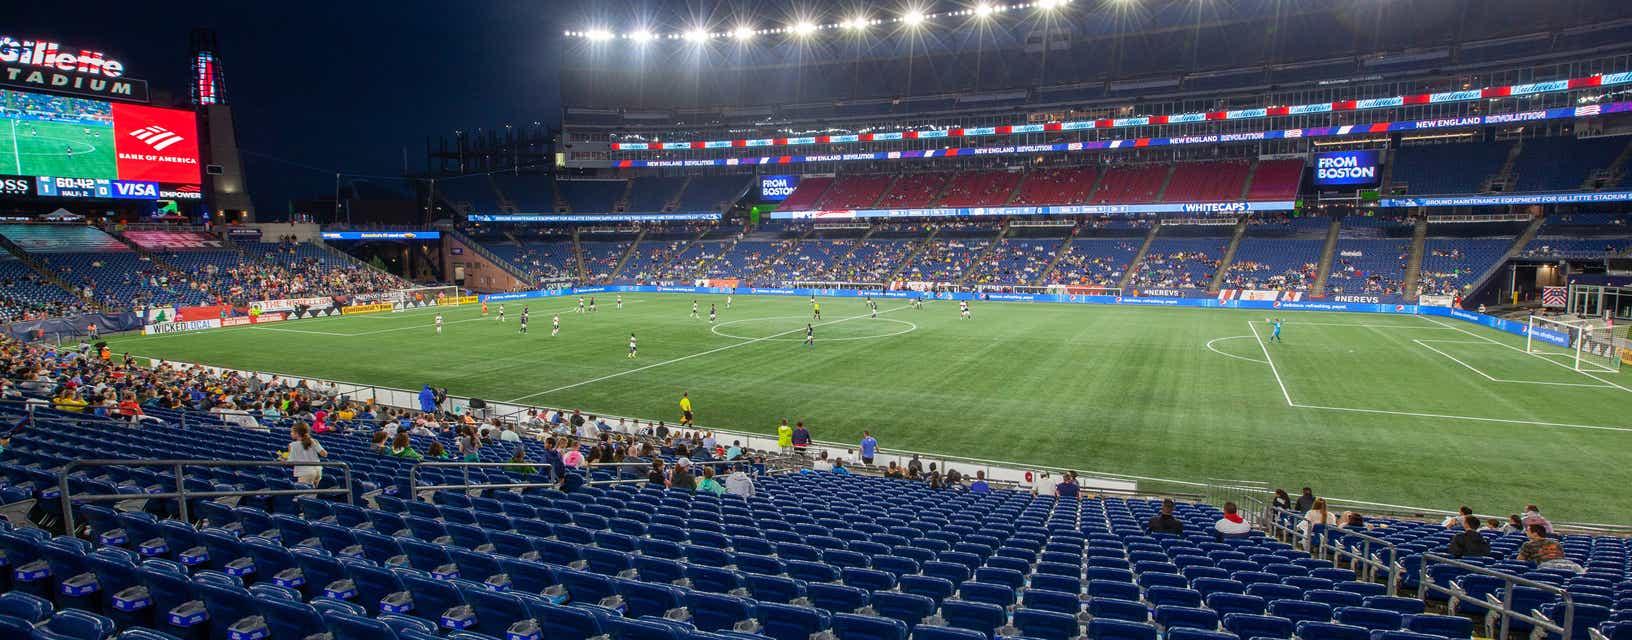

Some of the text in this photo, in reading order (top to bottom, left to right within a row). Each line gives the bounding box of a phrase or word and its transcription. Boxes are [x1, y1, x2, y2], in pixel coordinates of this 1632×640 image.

[0, 36, 124, 78] Gillette
[1416, 111, 1546, 128] NEW ENGLAND REVOLUTION
[1186, 136, 1218, 144] ENGLAND
[159, 156, 196, 164] AMERICA
[1318, 156, 1358, 168] FROM
[1318, 166, 1375, 178] BOSTON
[56, 178, 95, 188] 60:42
[762, 179, 786, 188] FROM
[44, 184, 48, 192] 1
[100, 186, 108, 195] 0
[114, 182, 156, 196] VISA
[160, 190, 201, 198] EMPOWER
[1186, 203, 1245, 212] WHITECAPS
[264, 300, 281, 308] THE
[1334, 295, 1379, 304] #NEREVS
